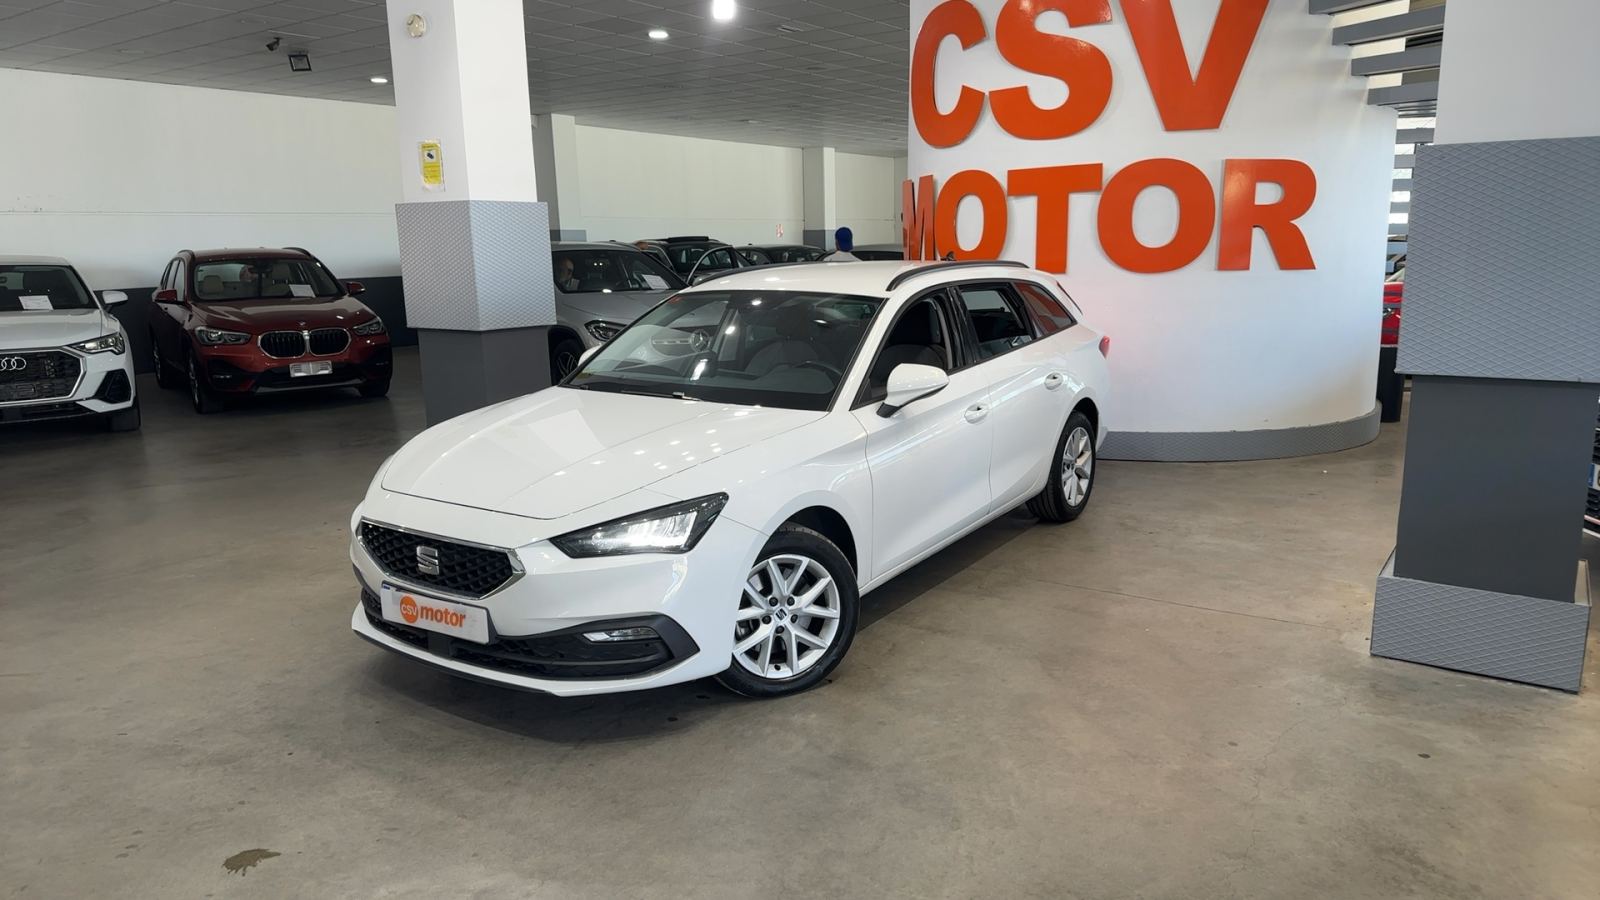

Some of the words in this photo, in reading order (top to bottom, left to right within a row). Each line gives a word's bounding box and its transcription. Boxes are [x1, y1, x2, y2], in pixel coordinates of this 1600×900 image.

[911, 0, 1269, 148] CSV
[903, 158, 1317, 274] MOTOR
[420, 605, 466, 627] motor
